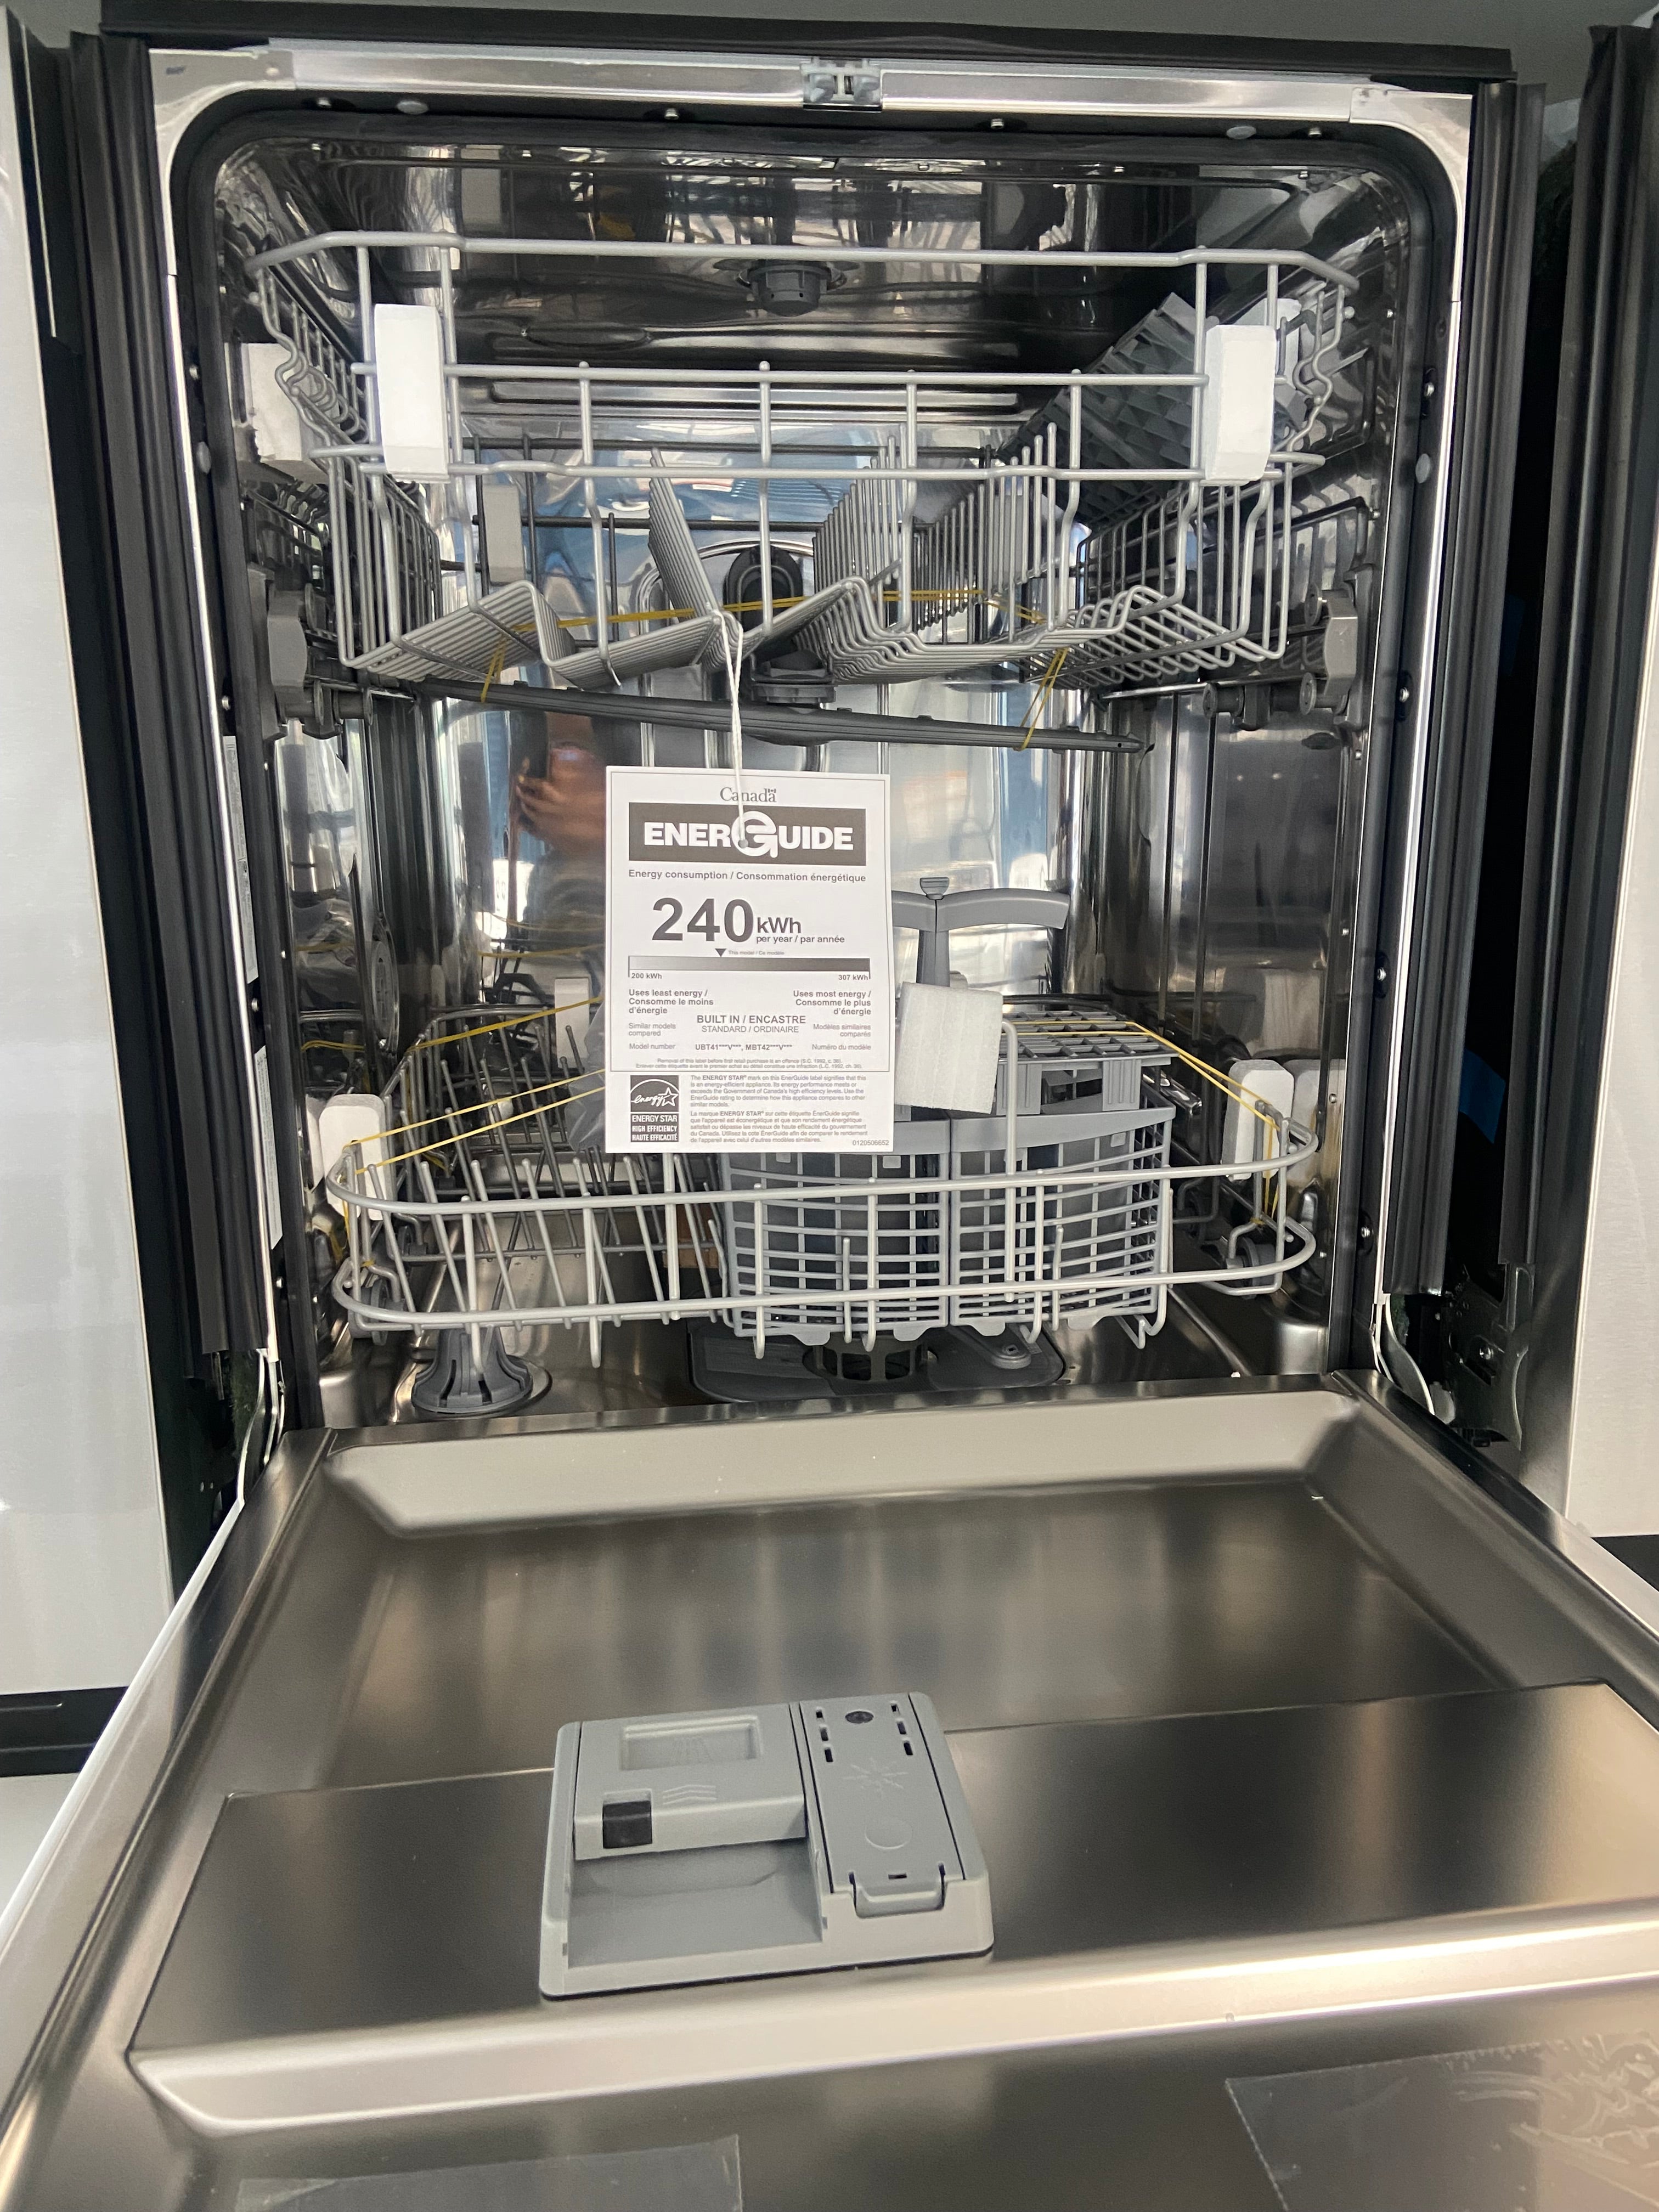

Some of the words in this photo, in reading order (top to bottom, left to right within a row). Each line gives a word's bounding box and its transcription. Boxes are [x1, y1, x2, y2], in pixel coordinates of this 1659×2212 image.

[644, 811, 854, 858] ENERGUIDE
[629, 870, 662, 879] Energy
[665, 871, 727, 880] consumption
[737, 872, 807, 881] Consommation
[811, 873, 866, 882] énergétique
[652, 898, 754, 943] 240
[757, 917, 802, 933] kWh
[629, 1007, 668, 1015] d'énergie
[697, 1015, 727, 1023] BUILT
[730, 1015, 740, 1023] IN
[749, 1015, 806, 1024] ENCASTRE
[650, 1132, 678, 1141] EFFICACITÉ
